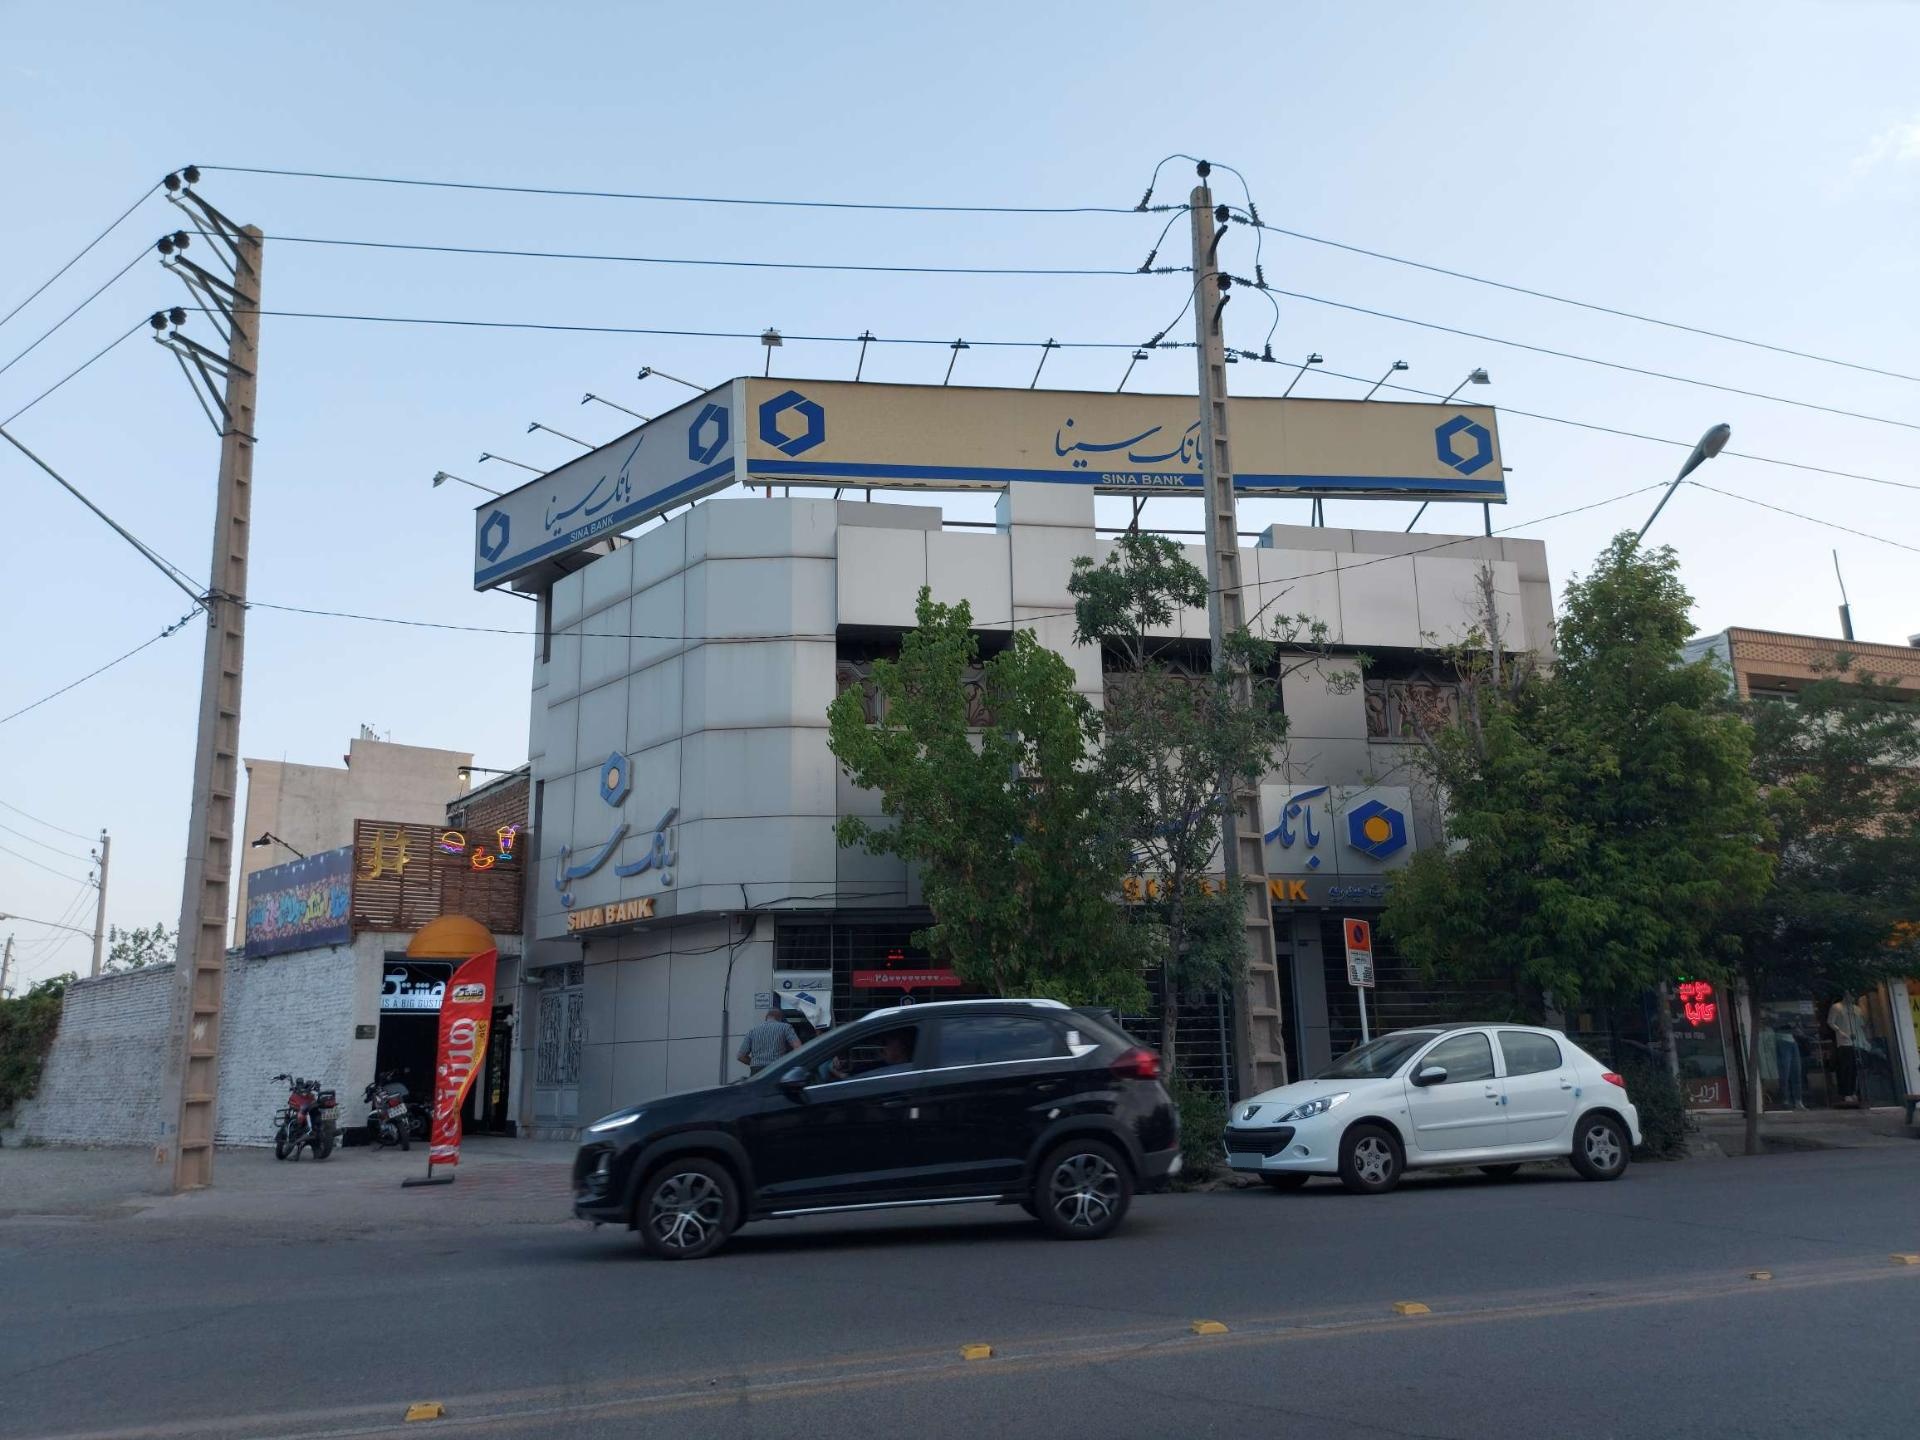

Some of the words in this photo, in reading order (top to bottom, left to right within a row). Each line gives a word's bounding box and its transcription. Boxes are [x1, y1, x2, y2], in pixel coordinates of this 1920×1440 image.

[1055, 418, 1162, 468] سینا
[585, 434, 645, 516] بانک
[1102, 474, 1137, 485] SINA
[1141, 475, 1184, 486] BANK
[545, 475, 606, 536] سینا
[570, 527, 590, 543] SINA
[590, 515, 614, 536] BANK
[554, 823, 630, 907] سینا
[614, 807, 680, 887] بانک
[567, 908, 605, 932] SINA
[605, 897, 655, 923] BANK
